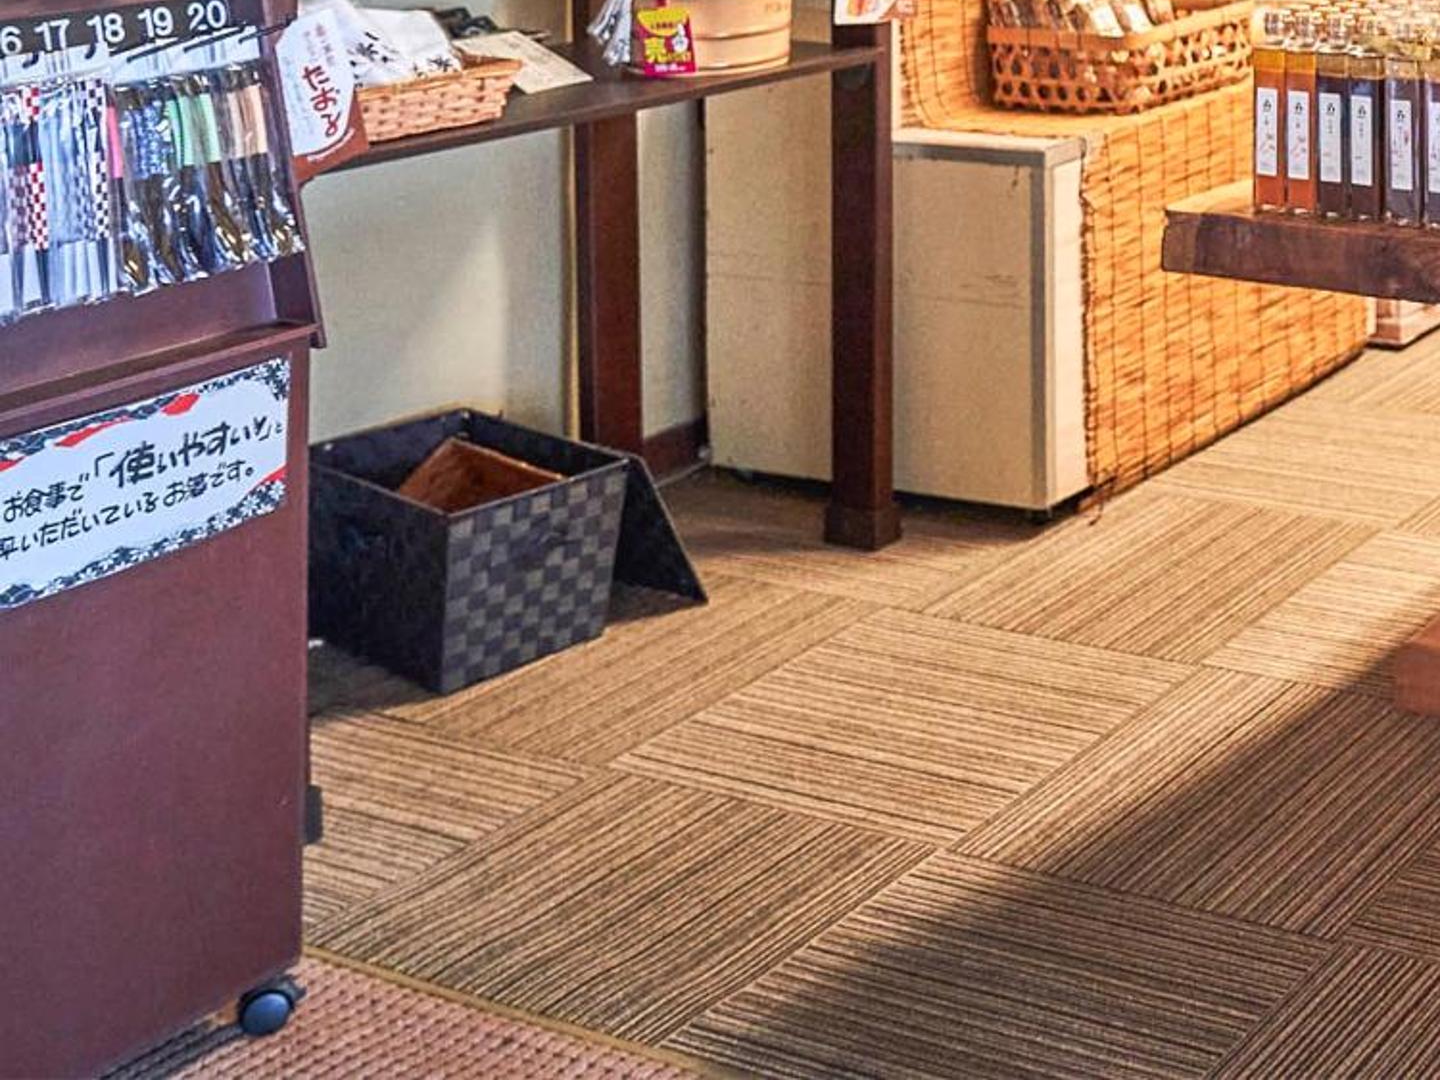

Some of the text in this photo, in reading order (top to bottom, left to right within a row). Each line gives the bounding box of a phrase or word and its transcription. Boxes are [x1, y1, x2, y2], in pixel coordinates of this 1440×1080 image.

[35, 20, 70, 52] 17
[88, 12, 126, 44] 18
[138, 8, 174, 39] 19
[187, 0, 227, 31] 20
